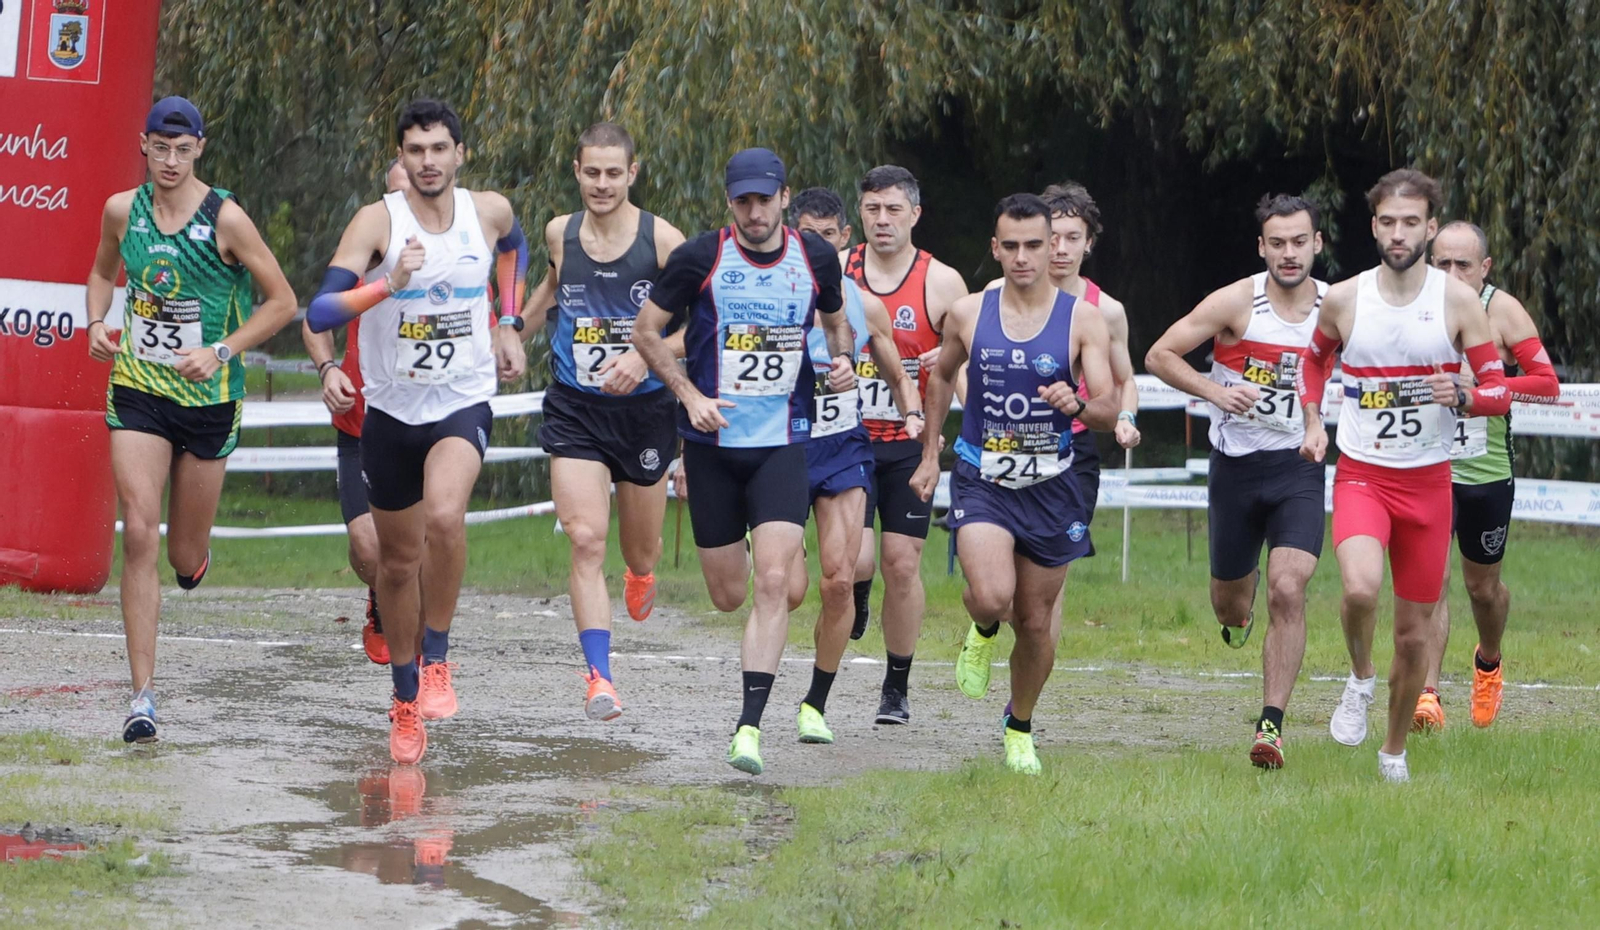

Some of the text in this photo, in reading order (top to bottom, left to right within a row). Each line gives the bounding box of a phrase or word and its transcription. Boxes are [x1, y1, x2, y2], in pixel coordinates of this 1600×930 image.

[148, 244, 178, 256] LUCUS
[728, 302, 775, 311] CONCELLO
[733, 312, 769, 320] DE VIGO
[141, 319, 182, 350] 33
[412, 341, 455, 370] 29
[738, 353, 783, 381] 28
[1256, 387, 1295, 418] 31
[1376, 408, 1422, 439] 25
[997, 456, 1042, 482] 24
